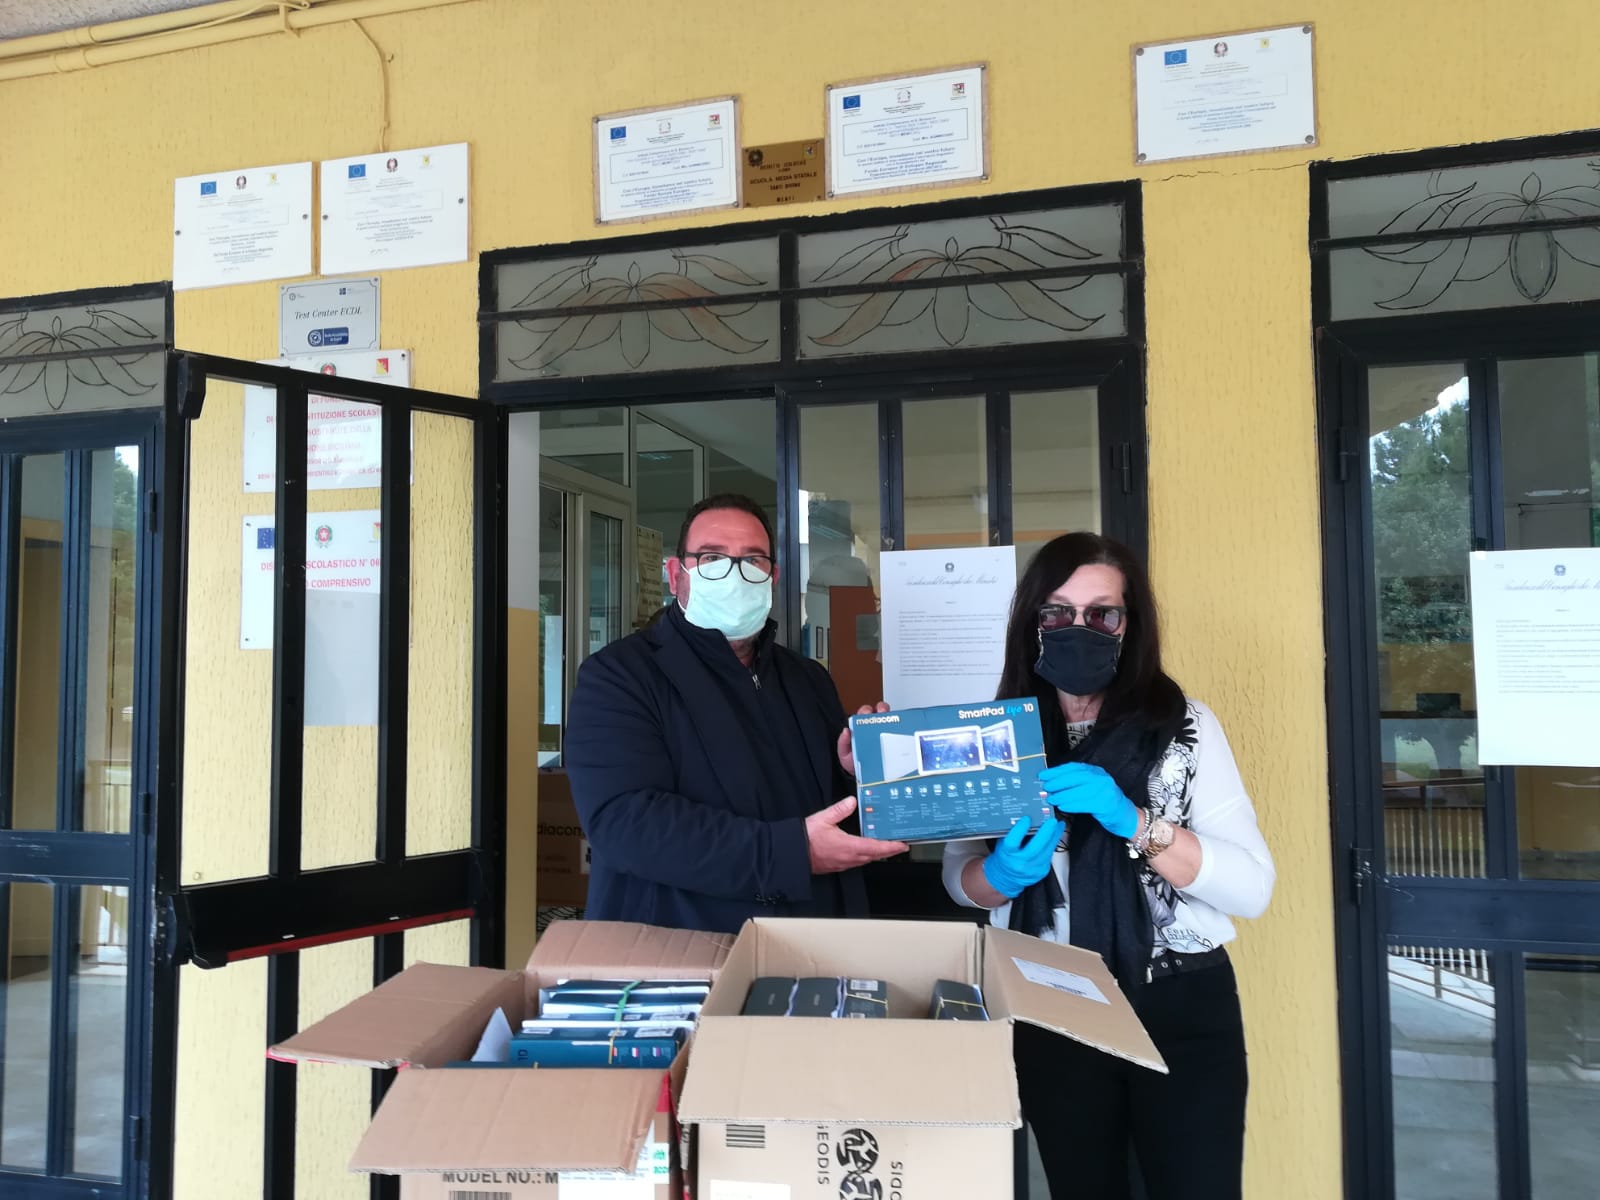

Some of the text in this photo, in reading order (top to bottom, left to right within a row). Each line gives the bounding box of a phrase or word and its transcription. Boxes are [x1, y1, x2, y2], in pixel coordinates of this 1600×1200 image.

[295, 305, 362, 320] Test Center ECDL
[308, 410, 346, 420] TITUZIONE
[311, 578, 371, 588] COMPRENSIVO
[856, 715, 900, 726] mediacom
[958, 706, 1005, 720] SmartPad
[1023, 703, 1034, 713] 10
[537, 822, 586, 838] diacom
[816, 1125, 831, 1185] EODIS
[442, 1171, 503, 1184] MODEL
[544, 1171, 559, 1185] M
[889, 1160, 904, 1200] ODIS
